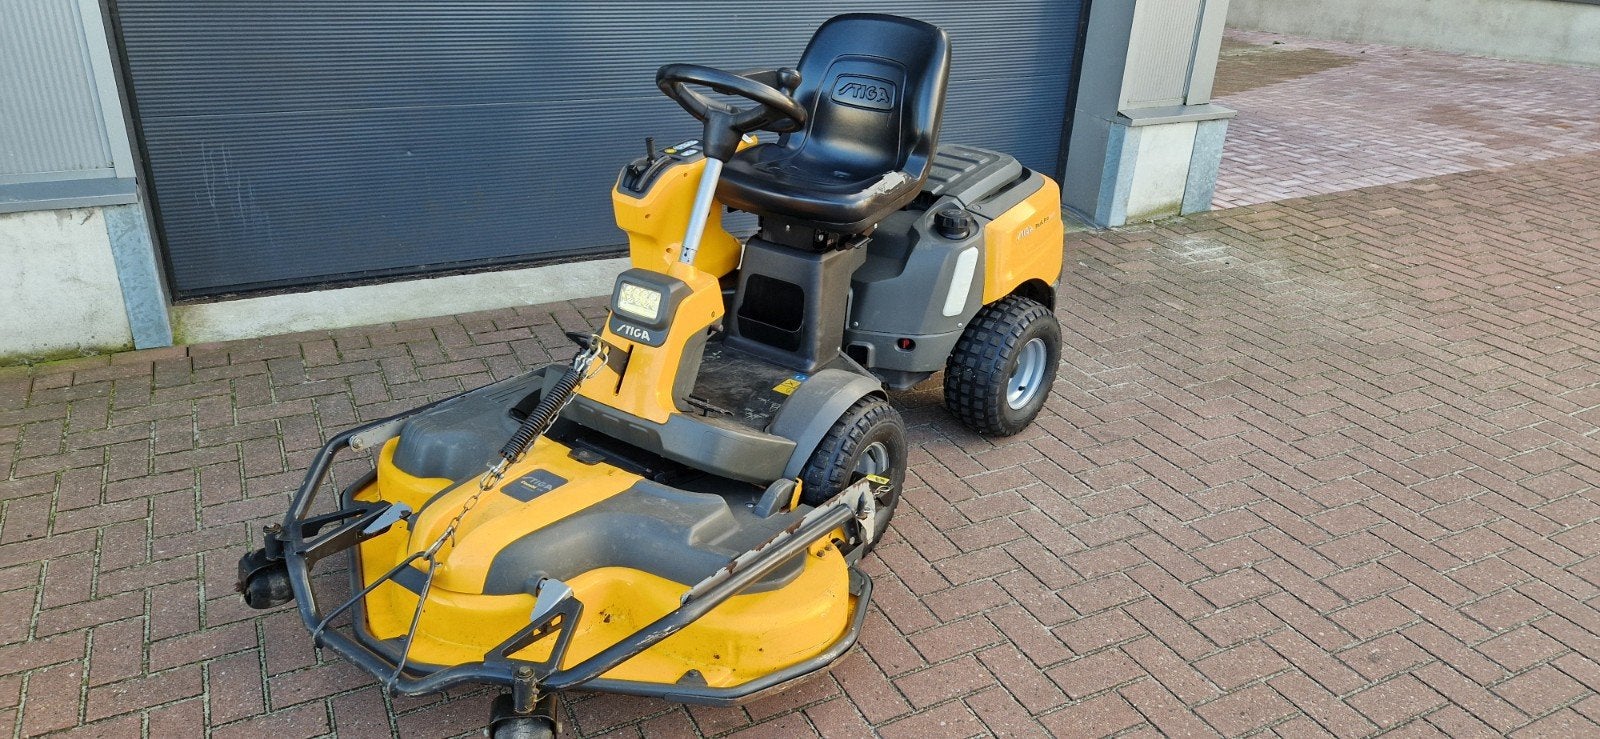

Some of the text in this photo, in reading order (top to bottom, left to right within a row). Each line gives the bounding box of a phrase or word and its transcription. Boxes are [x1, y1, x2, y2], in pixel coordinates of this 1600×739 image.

[838, 82, 890, 103] STIGA
[617, 324, 650, 341] STIGA
[521, 476, 552, 490] STIGA
